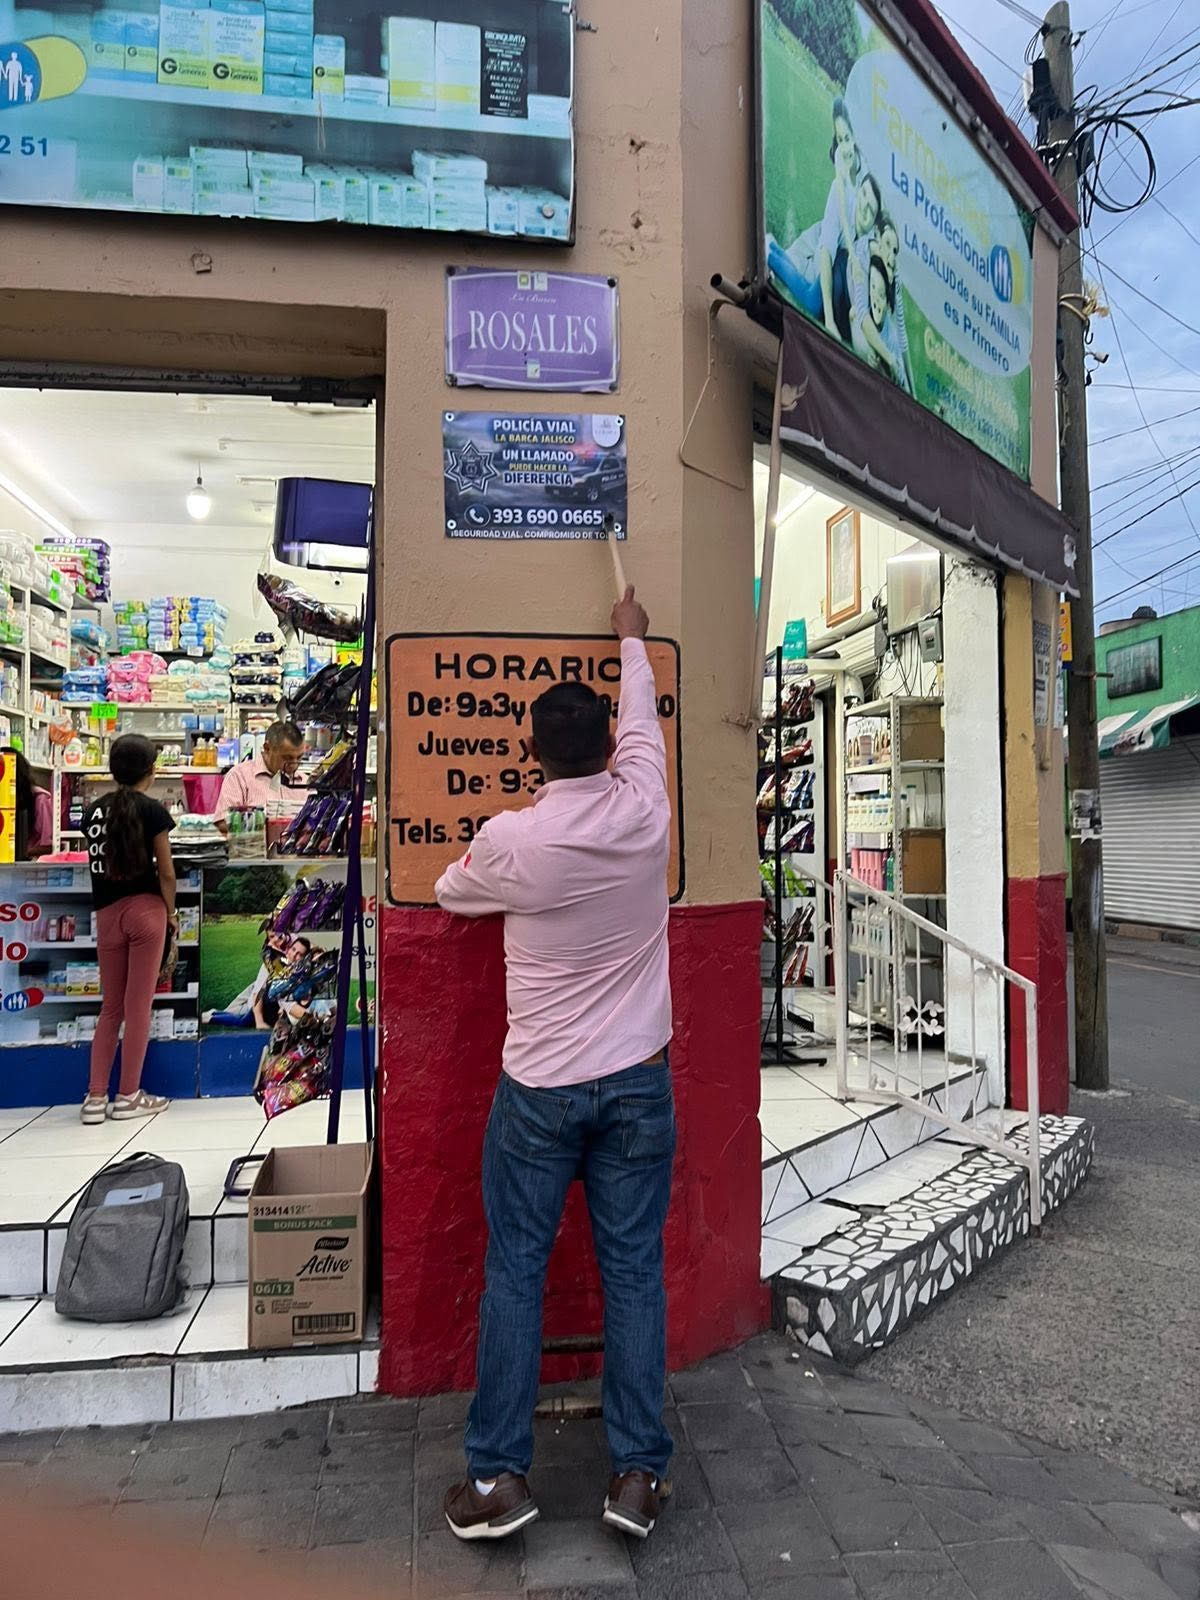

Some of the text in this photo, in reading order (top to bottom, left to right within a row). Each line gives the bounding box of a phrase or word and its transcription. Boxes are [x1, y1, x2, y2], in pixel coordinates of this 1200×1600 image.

[20, 136, 48, 157] 51
[890, 152, 910, 198] La
[904, 223, 920, 256] LA
[972, 293, 983, 316] su
[985, 303, 1020, 354] FAMILIA
[469, 310, 598, 355] ROSALES
[944, 301, 1009, 372] es Primero
[493, 417, 576, 433] POLICÍA VIAL
[495, 434, 575, 444] LA BARCA JALISCO
[503, 449, 574, 462] UN LLAMADO
[509, 463, 532, 471] PUEDE
[504, 472, 573, 485] DIFERENCIA
[493, 509, 602, 525] 393 690 0665
[525, 531, 581, 539] COMPROMISO
[582, 531, 593, 539] DE
[435, 653, 622, 683] HORARIO
[418, 731, 532, 763] Jueves y
[447, 768, 491, 795] De:
[391, 817, 452, 845] Tels.
[273, 1219, 334, 1230] BONUS PACK
[296, 1253, 352, 1276] Active
[255, 1284, 292, 1294] 06/12
